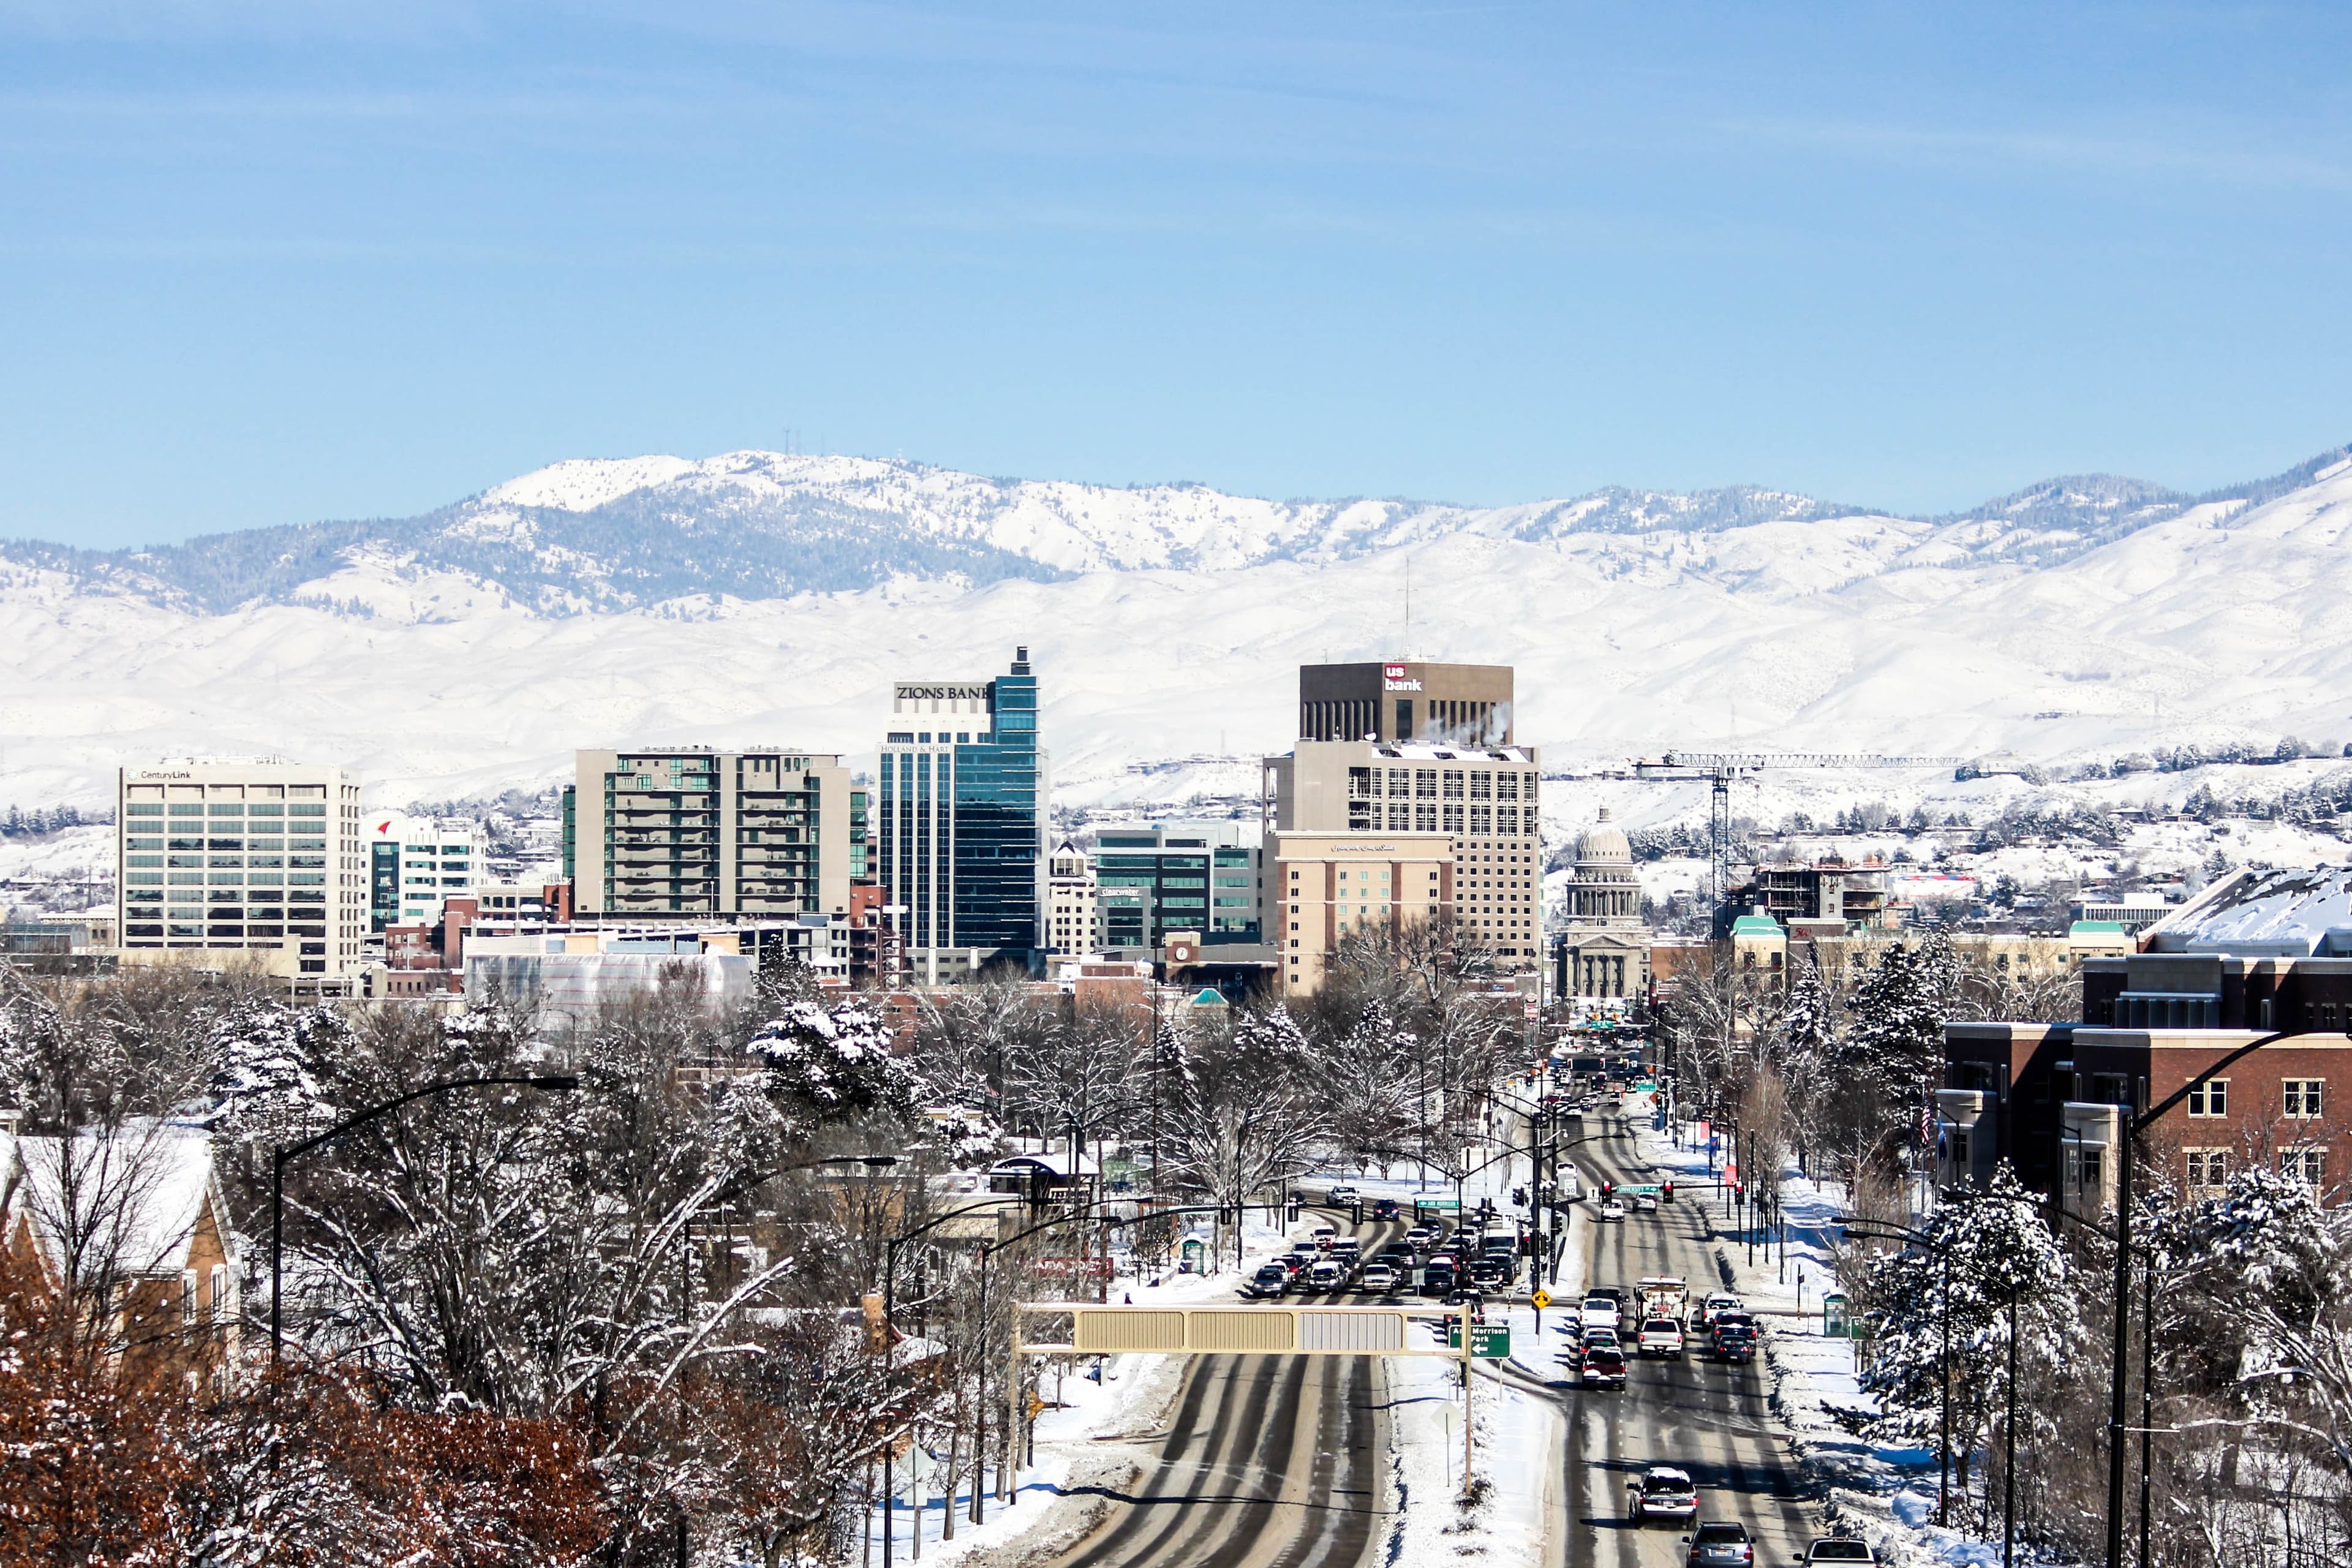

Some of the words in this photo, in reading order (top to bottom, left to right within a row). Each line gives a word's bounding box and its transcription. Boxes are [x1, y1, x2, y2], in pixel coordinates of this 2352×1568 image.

[1386, 667, 1404, 677] us
[1385, 678, 1422, 691] bank
[897, 687, 944, 699] ZIONS
[141, 771, 191, 779] CenturyLink
